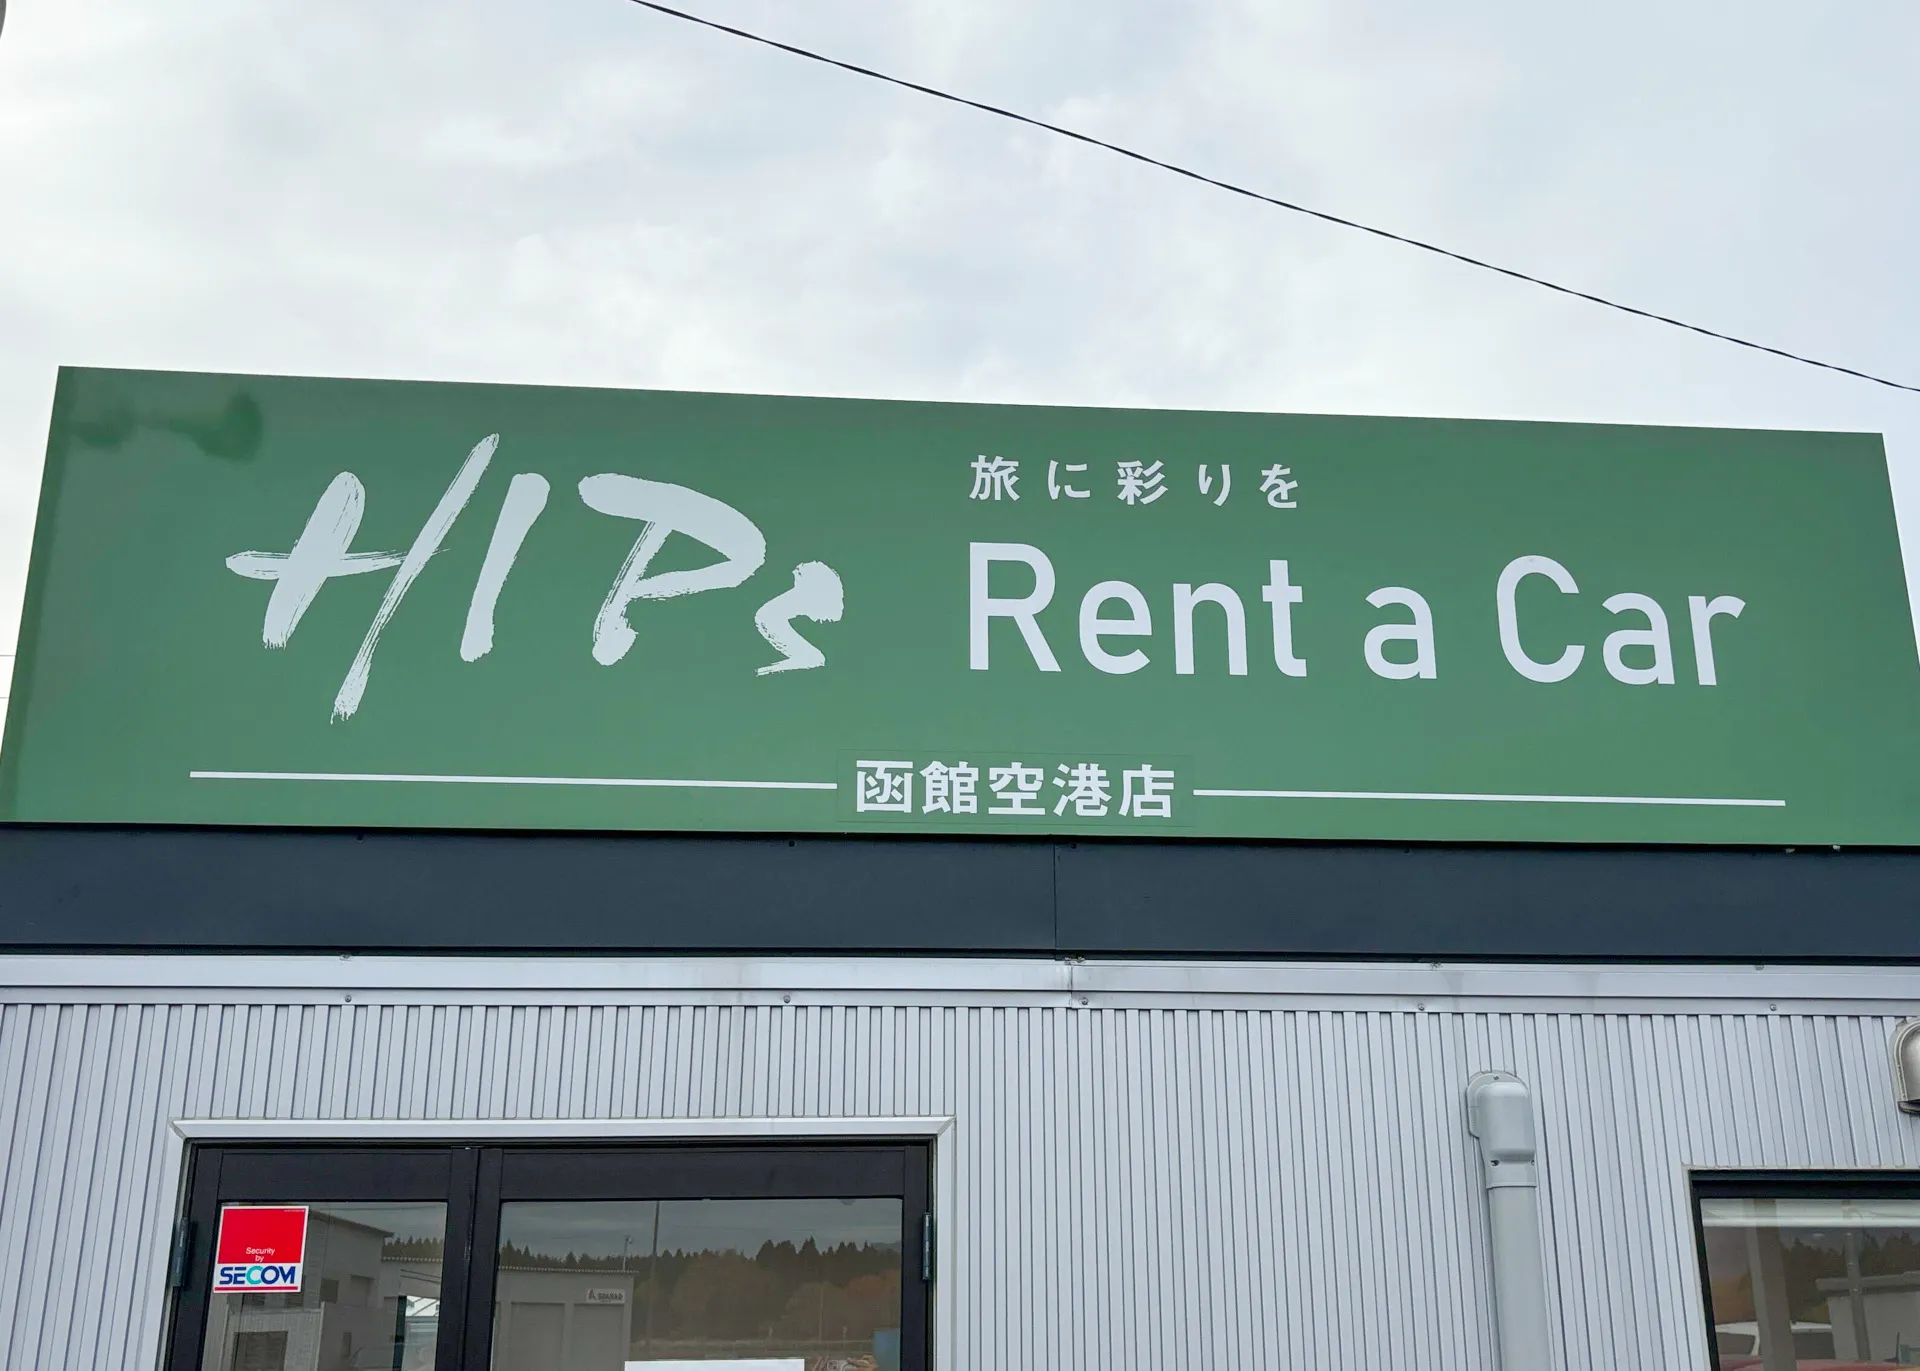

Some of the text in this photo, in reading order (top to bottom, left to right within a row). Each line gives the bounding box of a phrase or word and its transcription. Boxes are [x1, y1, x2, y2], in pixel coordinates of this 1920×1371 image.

[970, 455, 1299, 509] 旅に彩りを
[226, 433, 845, 722] HIPs
[969, 541, 1746, 686] Rent a Car
[856, 760, 1175, 818] 函館空港店
[219, 1265, 296, 1285] SECOM
[245, 1246, 275, 1256] Security
[255, 1254, 264, 1263] by
